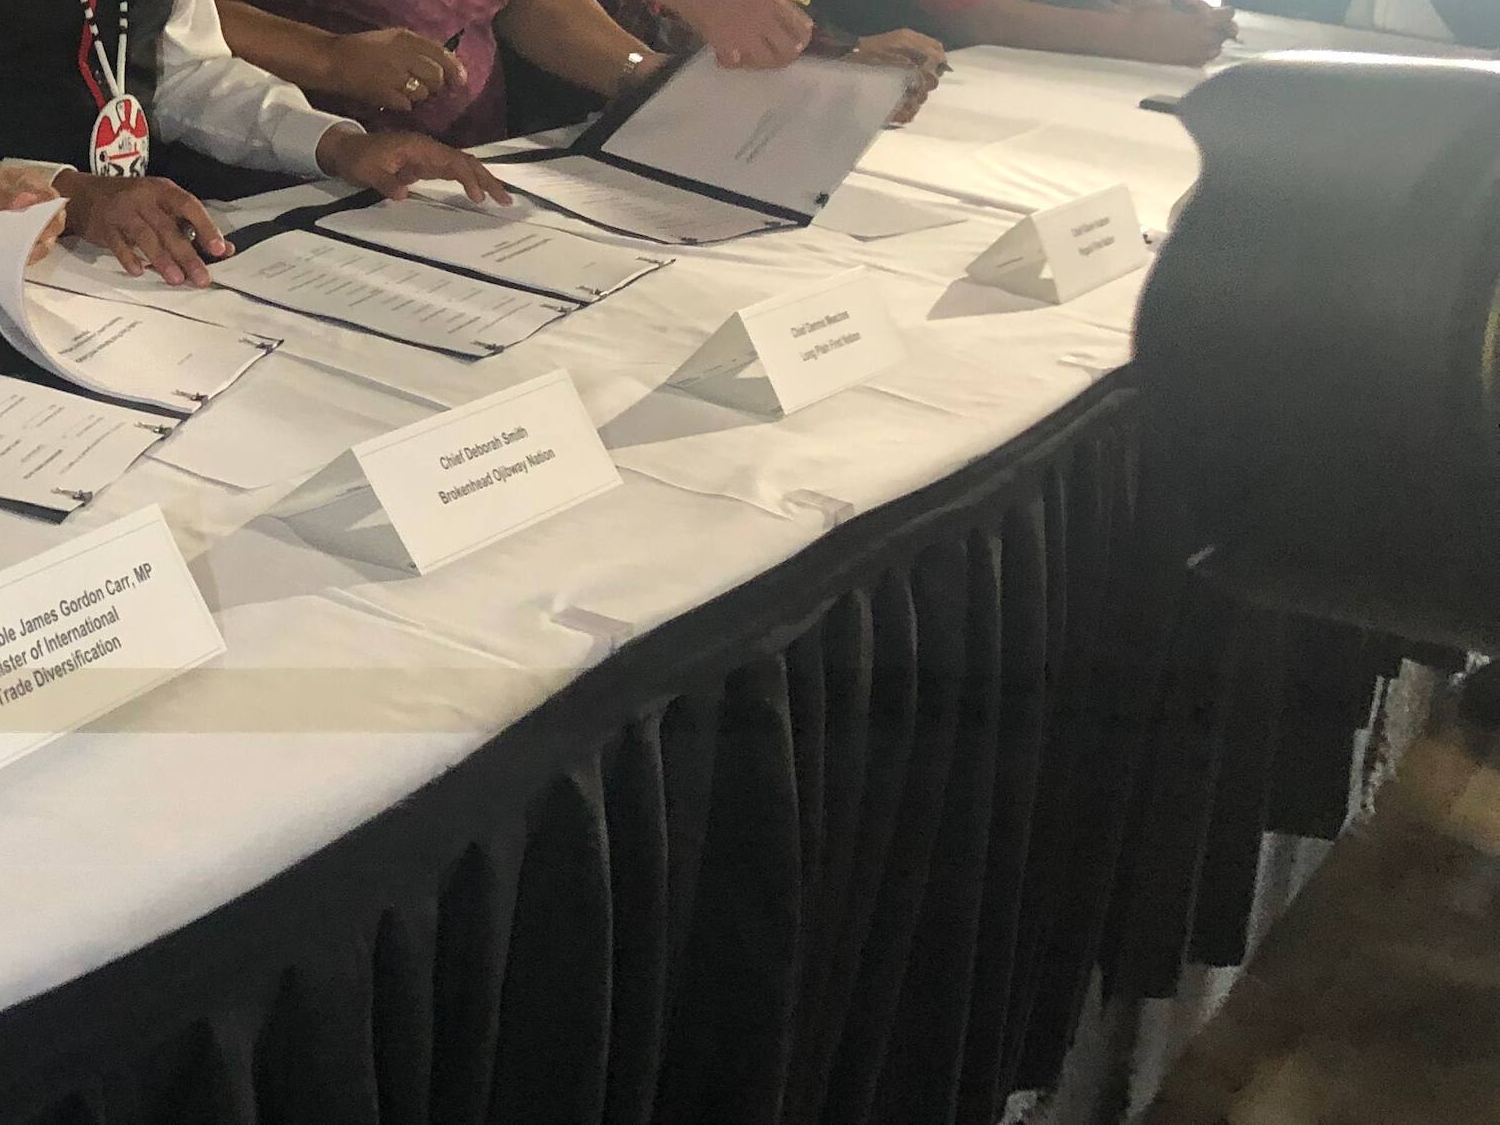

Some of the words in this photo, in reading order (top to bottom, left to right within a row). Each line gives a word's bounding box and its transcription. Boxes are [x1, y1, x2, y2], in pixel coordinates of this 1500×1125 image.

[439, 450, 465, 470] Chief
[463, 437, 503, 460] Deborah
[501, 426, 528, 445] Smith
[438, 472, 494, 505] Brokenhead
[492, 461, 528, 483] Ojibway
[525, 449, 555, 467] Nation
[20, 609, 59, 637] James
[59, 588, 105, 617] Gordon
[105, 576, 135, 595] Carr,
[133, 563, 152, 583] MP
[30, 640, 44, 660] of
[43, 605, 120, 653] International
[32, 636, 122, 688] Diversification
